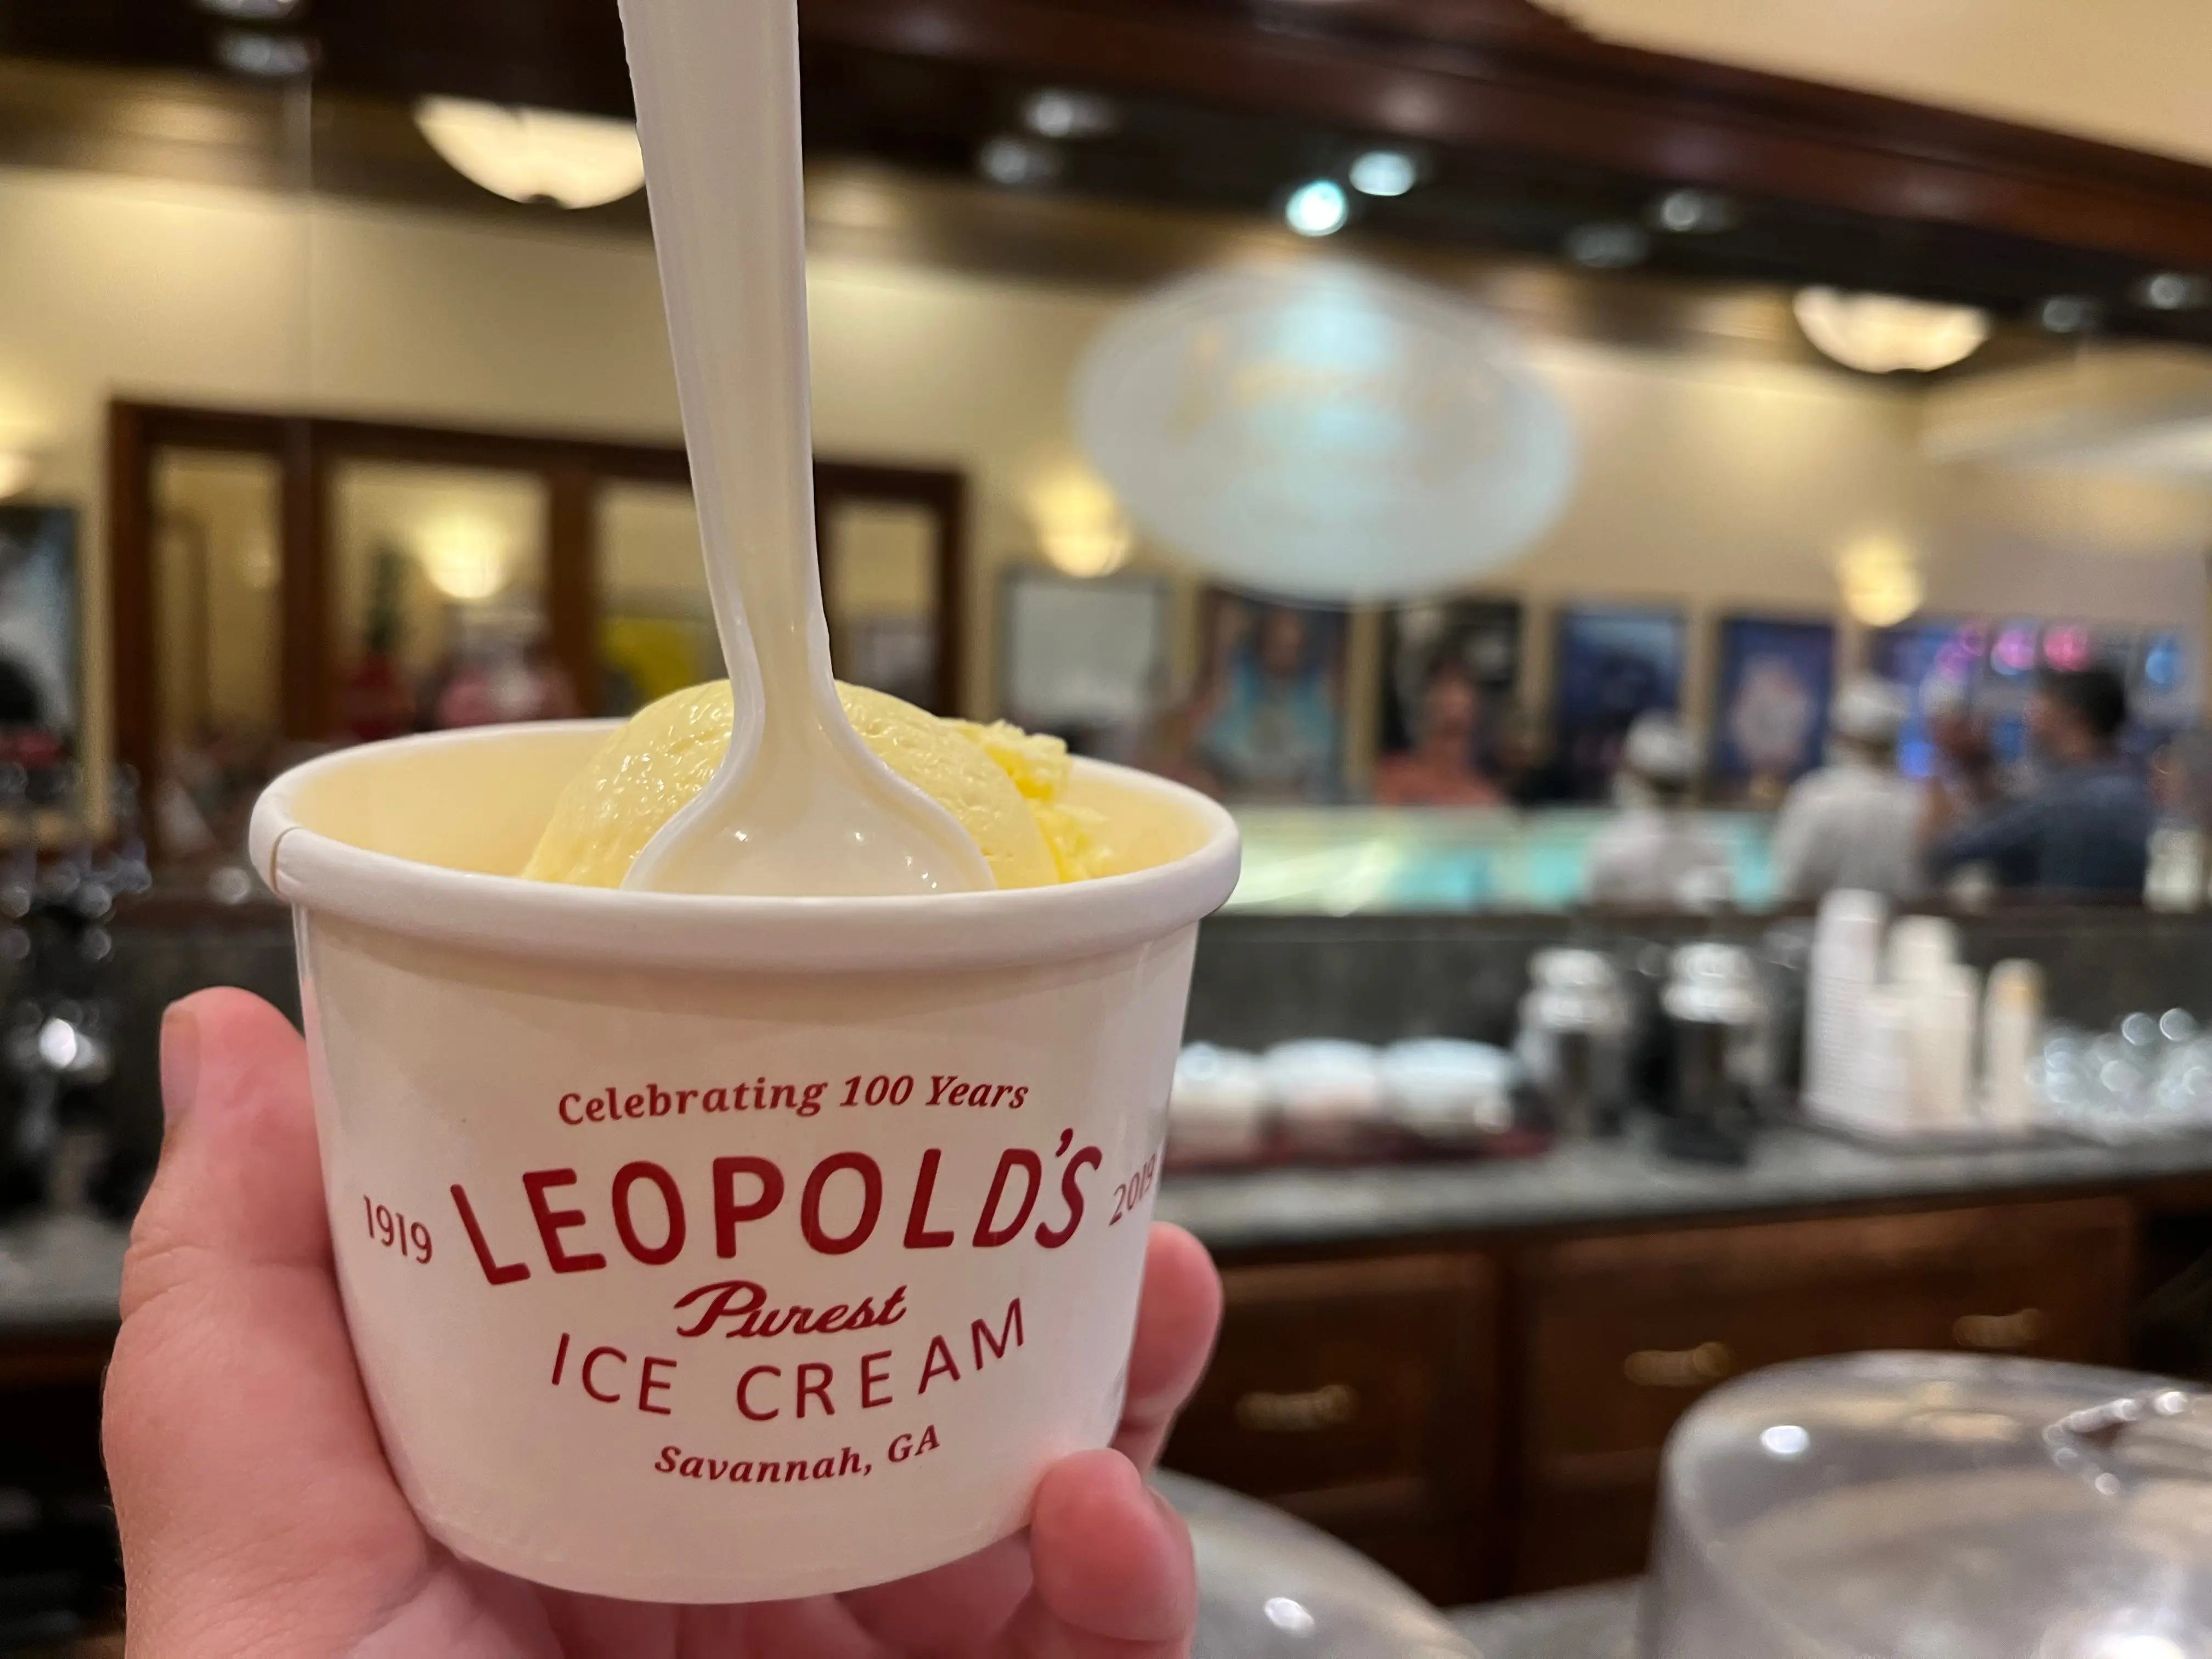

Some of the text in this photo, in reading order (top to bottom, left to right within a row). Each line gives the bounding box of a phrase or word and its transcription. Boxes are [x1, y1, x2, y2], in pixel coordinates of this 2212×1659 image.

[558, 1074, 1029, 1126] Celebrating 100 Years
[449, 1127, 1103, 1286] LEOPOLD'S
[1108, 1152, 1156, 1227] 2019
[363, 1196, 433, 1265] 1919
[673, 1278, 908, 1340] Purest
[550, 1297, 1025, 1423] ICE CREAM
[653, 1424, 940, 1484] Savannah, GA
